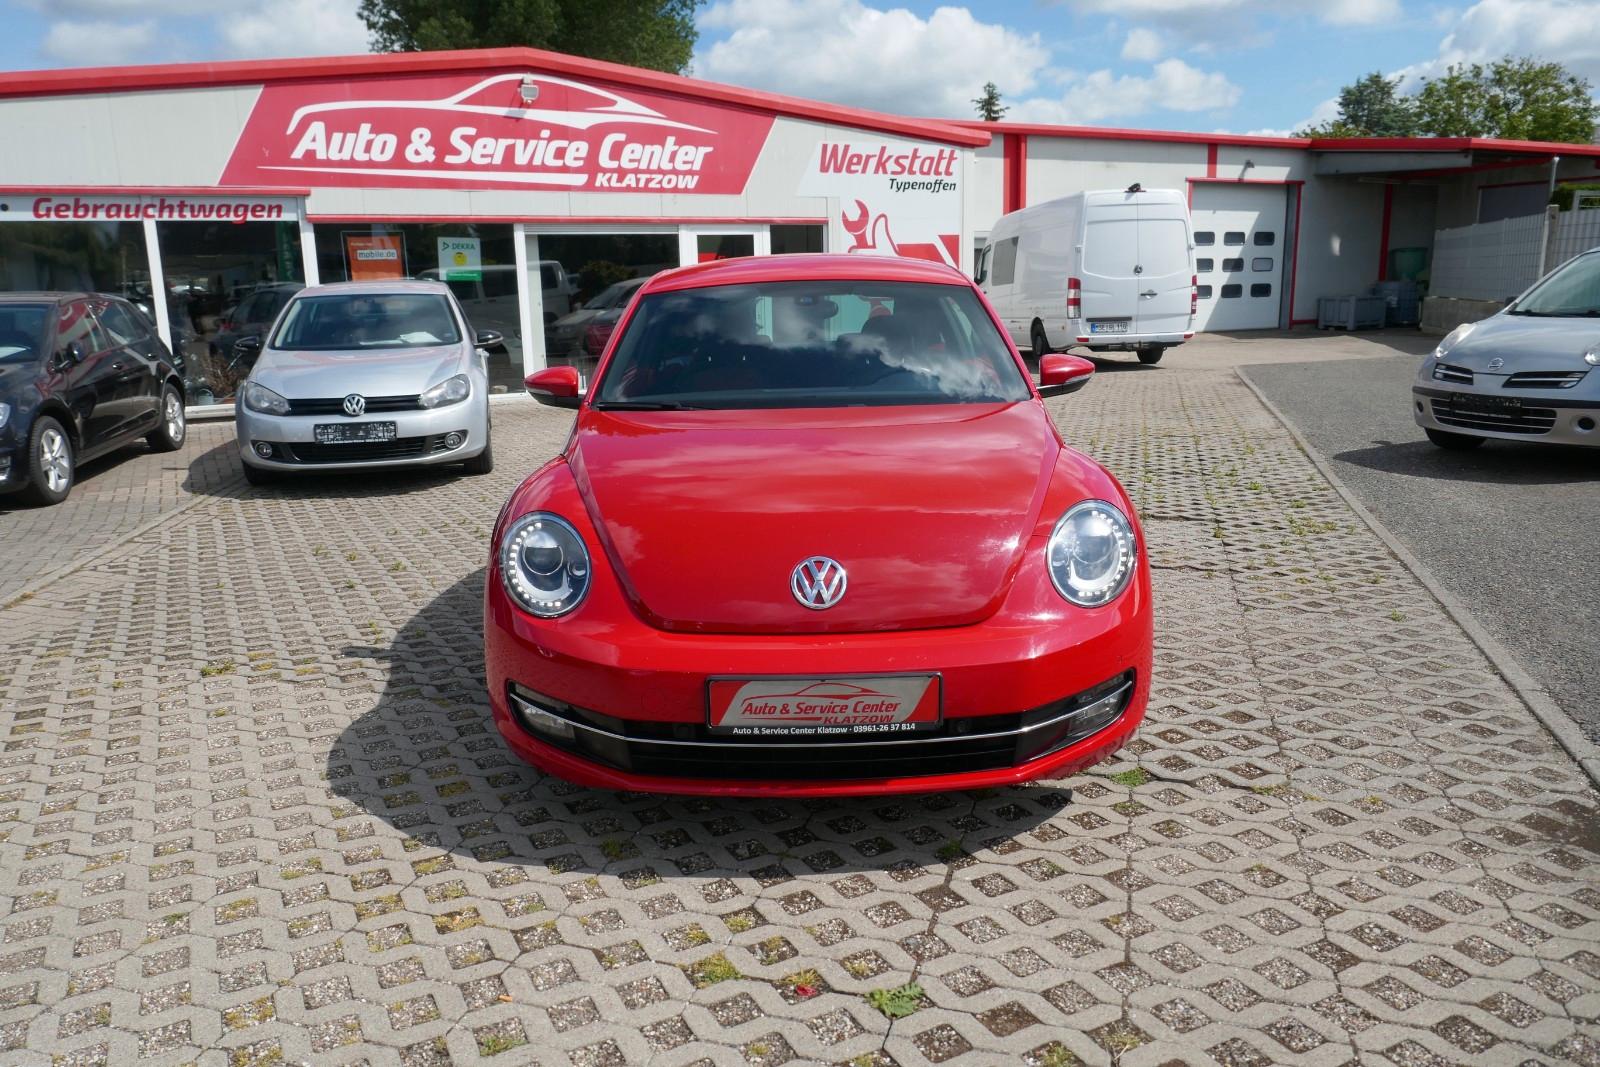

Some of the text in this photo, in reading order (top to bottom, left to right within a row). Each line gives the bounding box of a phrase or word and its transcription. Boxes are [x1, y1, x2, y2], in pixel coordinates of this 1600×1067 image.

[290, 121, 714, 172] Auto & Service Center
[819, 143, 958, 176] Werkstatt
[594, 172, 699, 190] KLATZOW
[889, 178, 957, 193] Typenoffen
[32, 197, 283, 224] Gebrauchtwagen
[451, 242, 476, 250] DEKRA
[358, 250, 396, 259] mobile.de
[791, 556, 847, 609] VW
[742, 700, 901, 715] Auto & Service Center
[824, 715, 894, 725] KLATZOW
[732, 727, 751, 735] Auto
[753, 727, 760, 735] &
[761, 727, 789, 735] Service
[790, 726, 816, 734] Center
[817, 725, 848, 734] Klatzow
[853, 723, 889, 733] 03961-26
[890, 723, 899, 732] 37
[901, 722, 916, 731] 814
